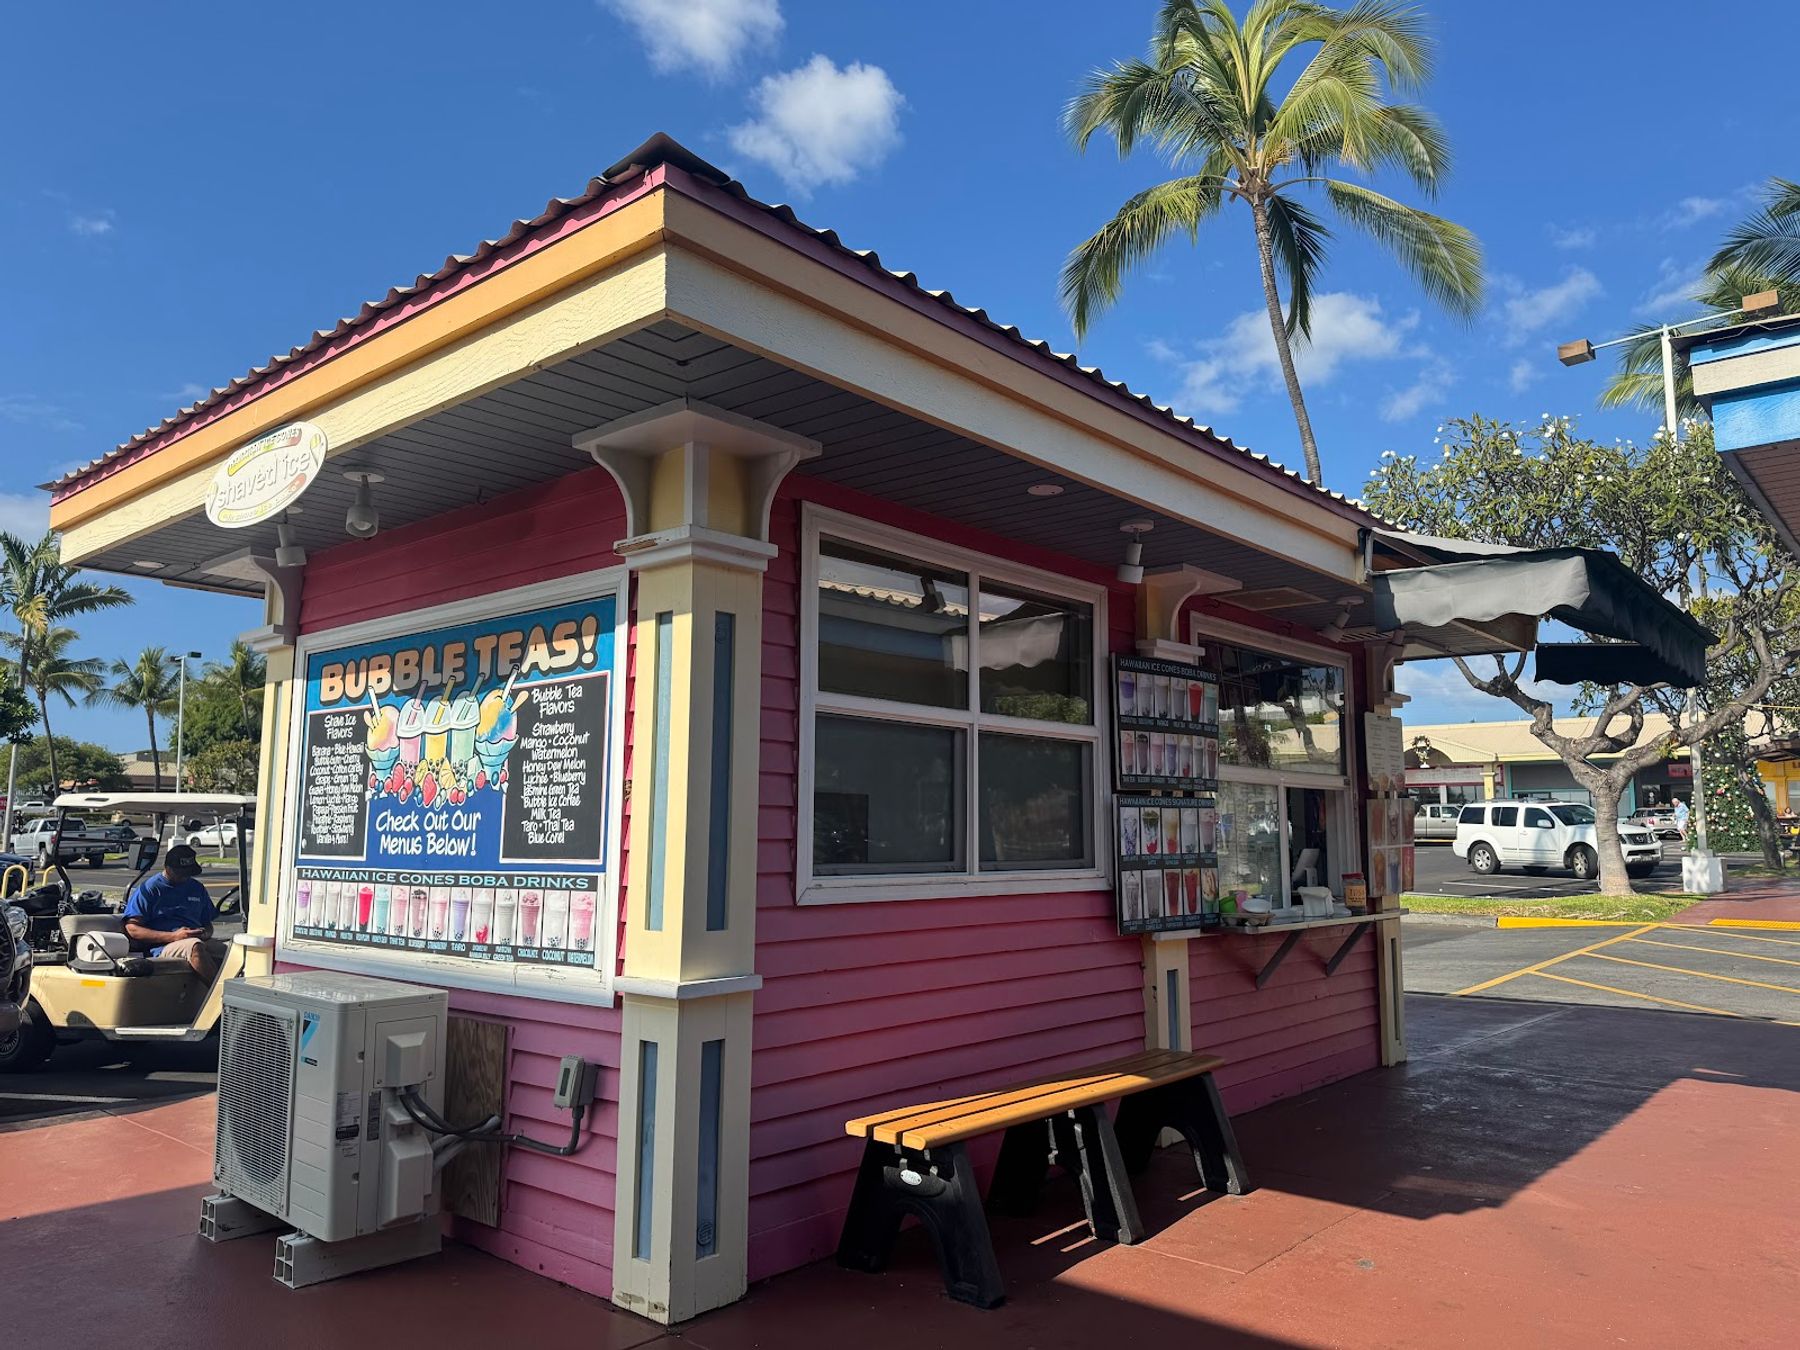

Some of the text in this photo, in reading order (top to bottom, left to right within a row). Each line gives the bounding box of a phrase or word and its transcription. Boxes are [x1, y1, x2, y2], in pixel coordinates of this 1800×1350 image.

[319, 615, 599, 703] BUBBLE TEAS!
[531, 683, 583, 704] Bubble Tea
[539, 699, 575, 719] Flavors
[324, 713, 357, 728] Shave Ice
[532, 720, 575, 737] Strawberry
[326, 727, 353, 739] Flavors
[520, 731, 591, 751] Mango Coconut
[531, 745, 578, 761] Watermelon
[522, 757, 586, 775] Honey Dew Melon
[553, 770, 586, 786] Blueberry
[548, 783, 566, 796] Green
[567, 782, 580, 795] Tea
[520, 793, 581, 809] Bubble Ice Coffee
[375, 808, 482, 832] Check Out Our
[530, 807, 562, 820] Milk Tea
[520, 818, 575, 833] Taro Thai Tea
[380, 832, 477, 857] Menus Below!
[527, 831, 545, 845] Blue
[302, 868, 590, 890] HAWAIIAN ICE CONES BOBA DRINKS
[451, 942, 466, 952] TARO
[541, 949, 566, 962] COCONUT
